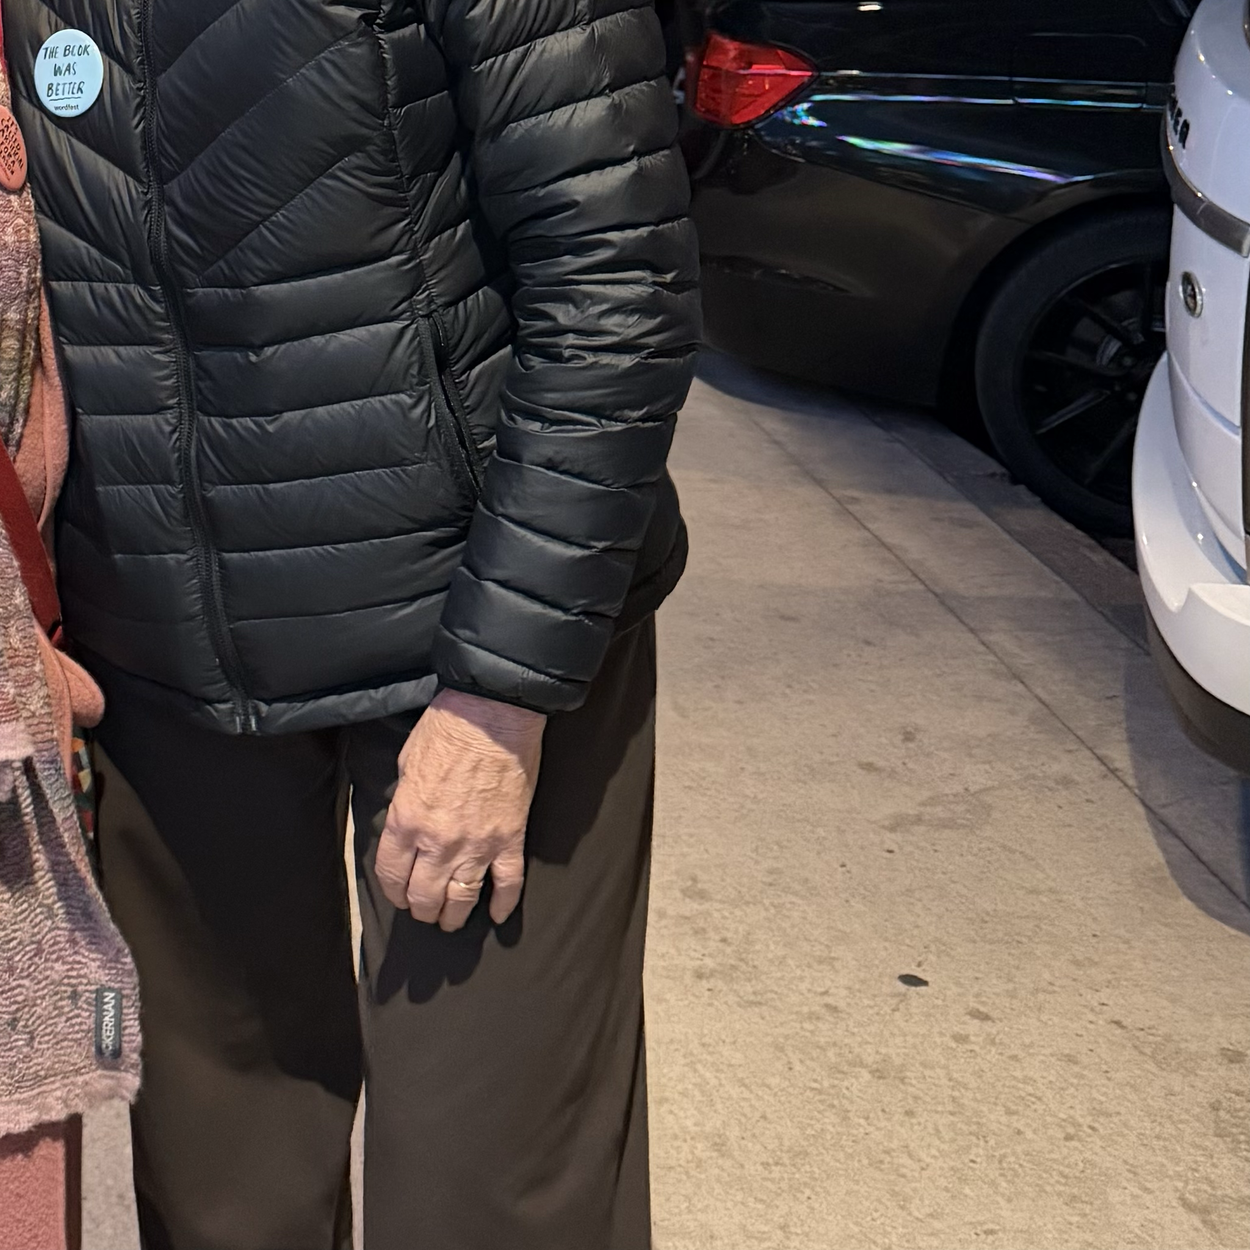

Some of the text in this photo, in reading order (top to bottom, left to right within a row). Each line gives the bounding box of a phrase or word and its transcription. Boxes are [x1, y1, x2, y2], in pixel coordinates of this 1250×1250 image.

[42, 45, 59, 60] THE
[53, 61, 77, 77] WAS
[46, 81, 85, 98] BETTER
[0, 118, 21, 151] CALLED
